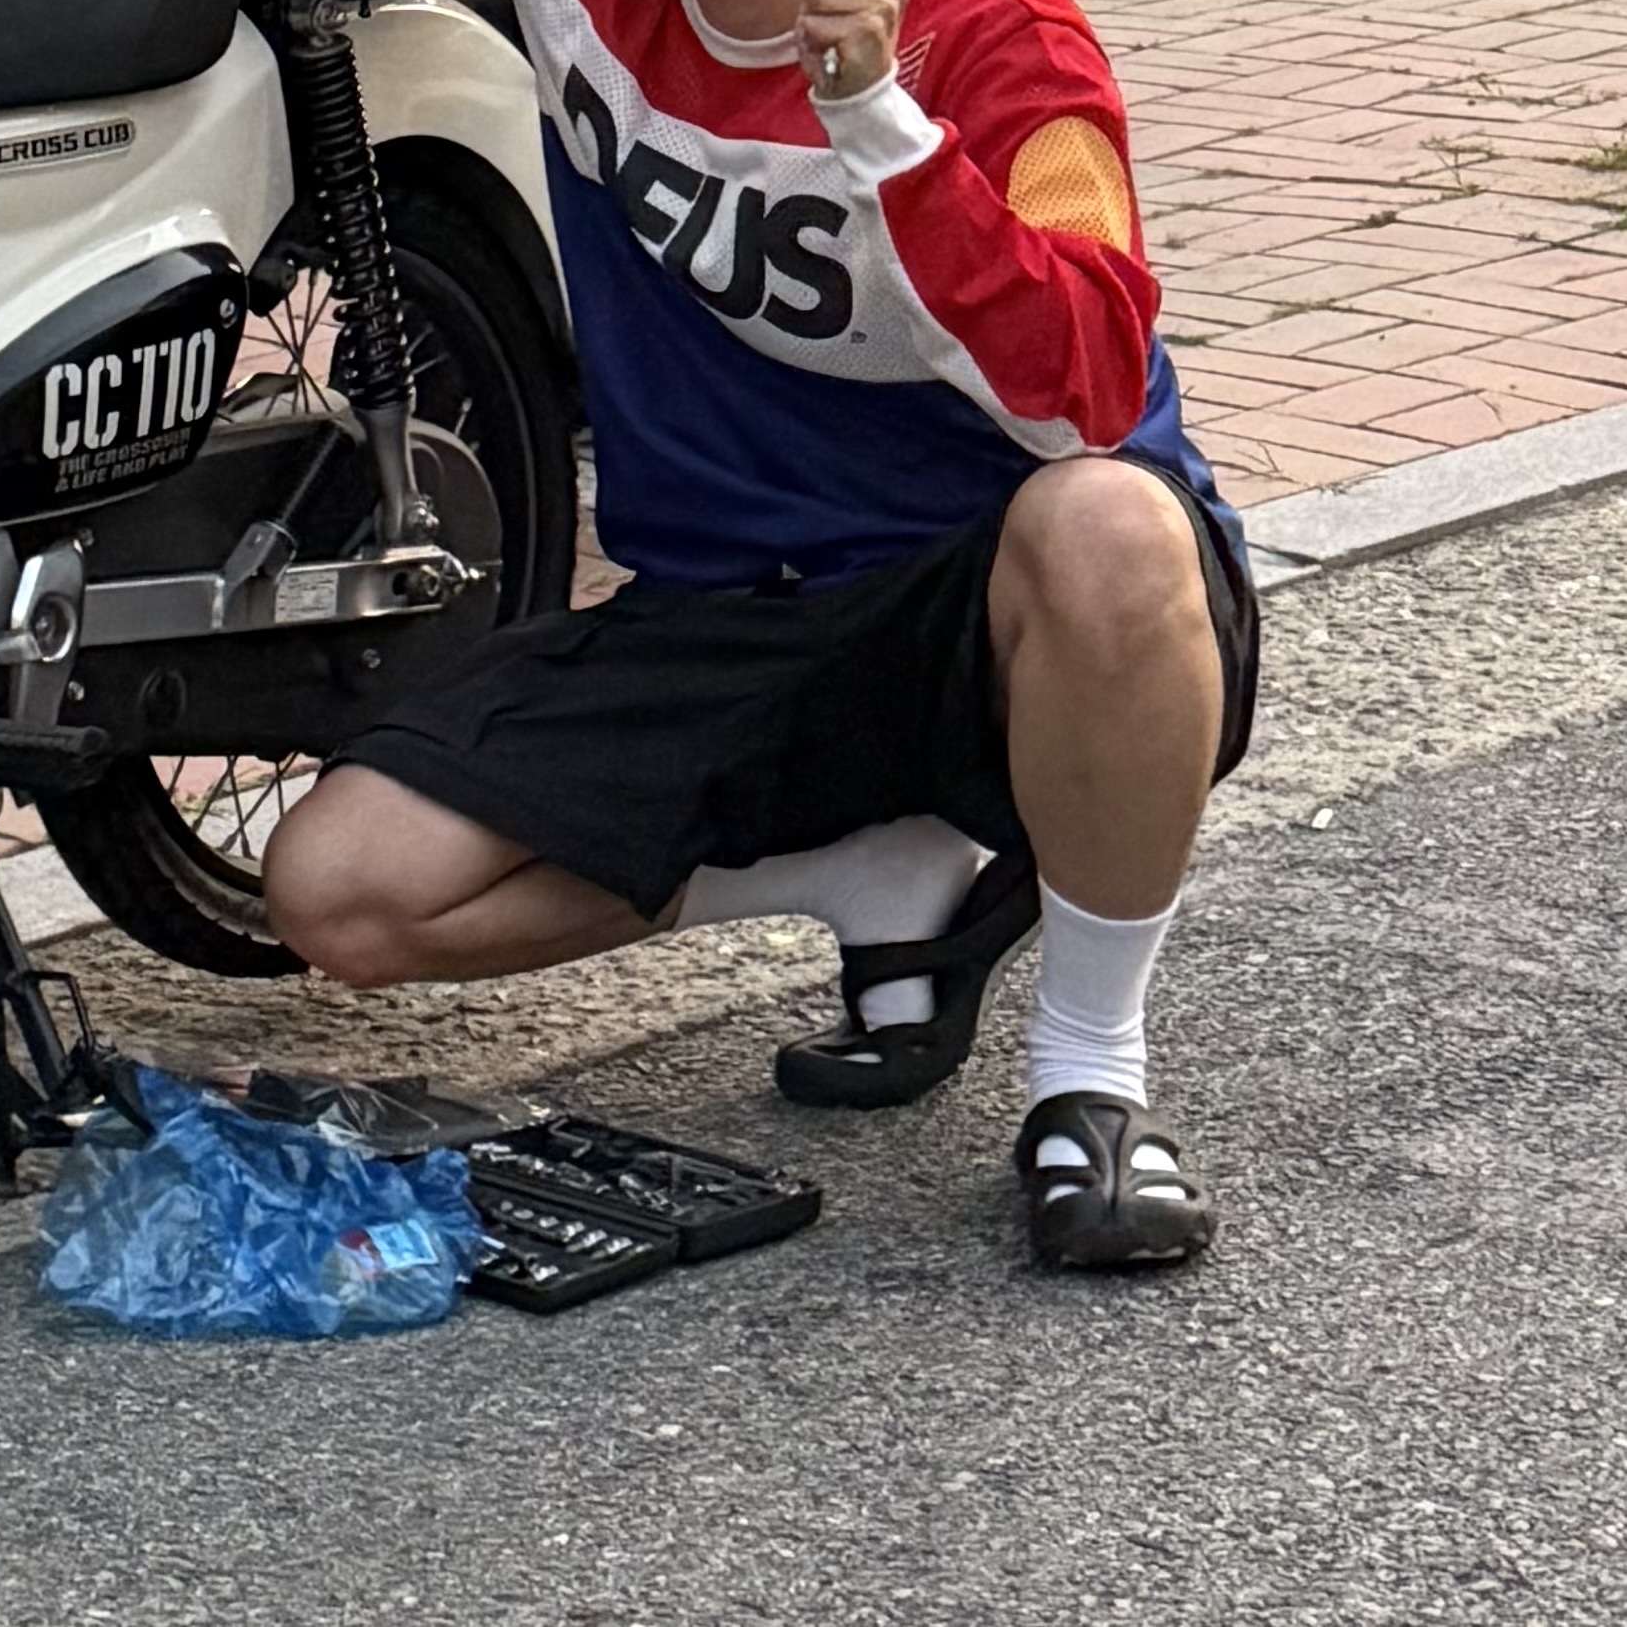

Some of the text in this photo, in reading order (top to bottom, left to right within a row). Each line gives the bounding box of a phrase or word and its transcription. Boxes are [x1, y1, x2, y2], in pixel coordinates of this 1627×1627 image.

[84, 123, 130, 148] CUB
[59, 426, 192, 477] THE CROSSOVER
[72, 467, 108, 490] LIFE
[111, 457, 146, 480] AND
